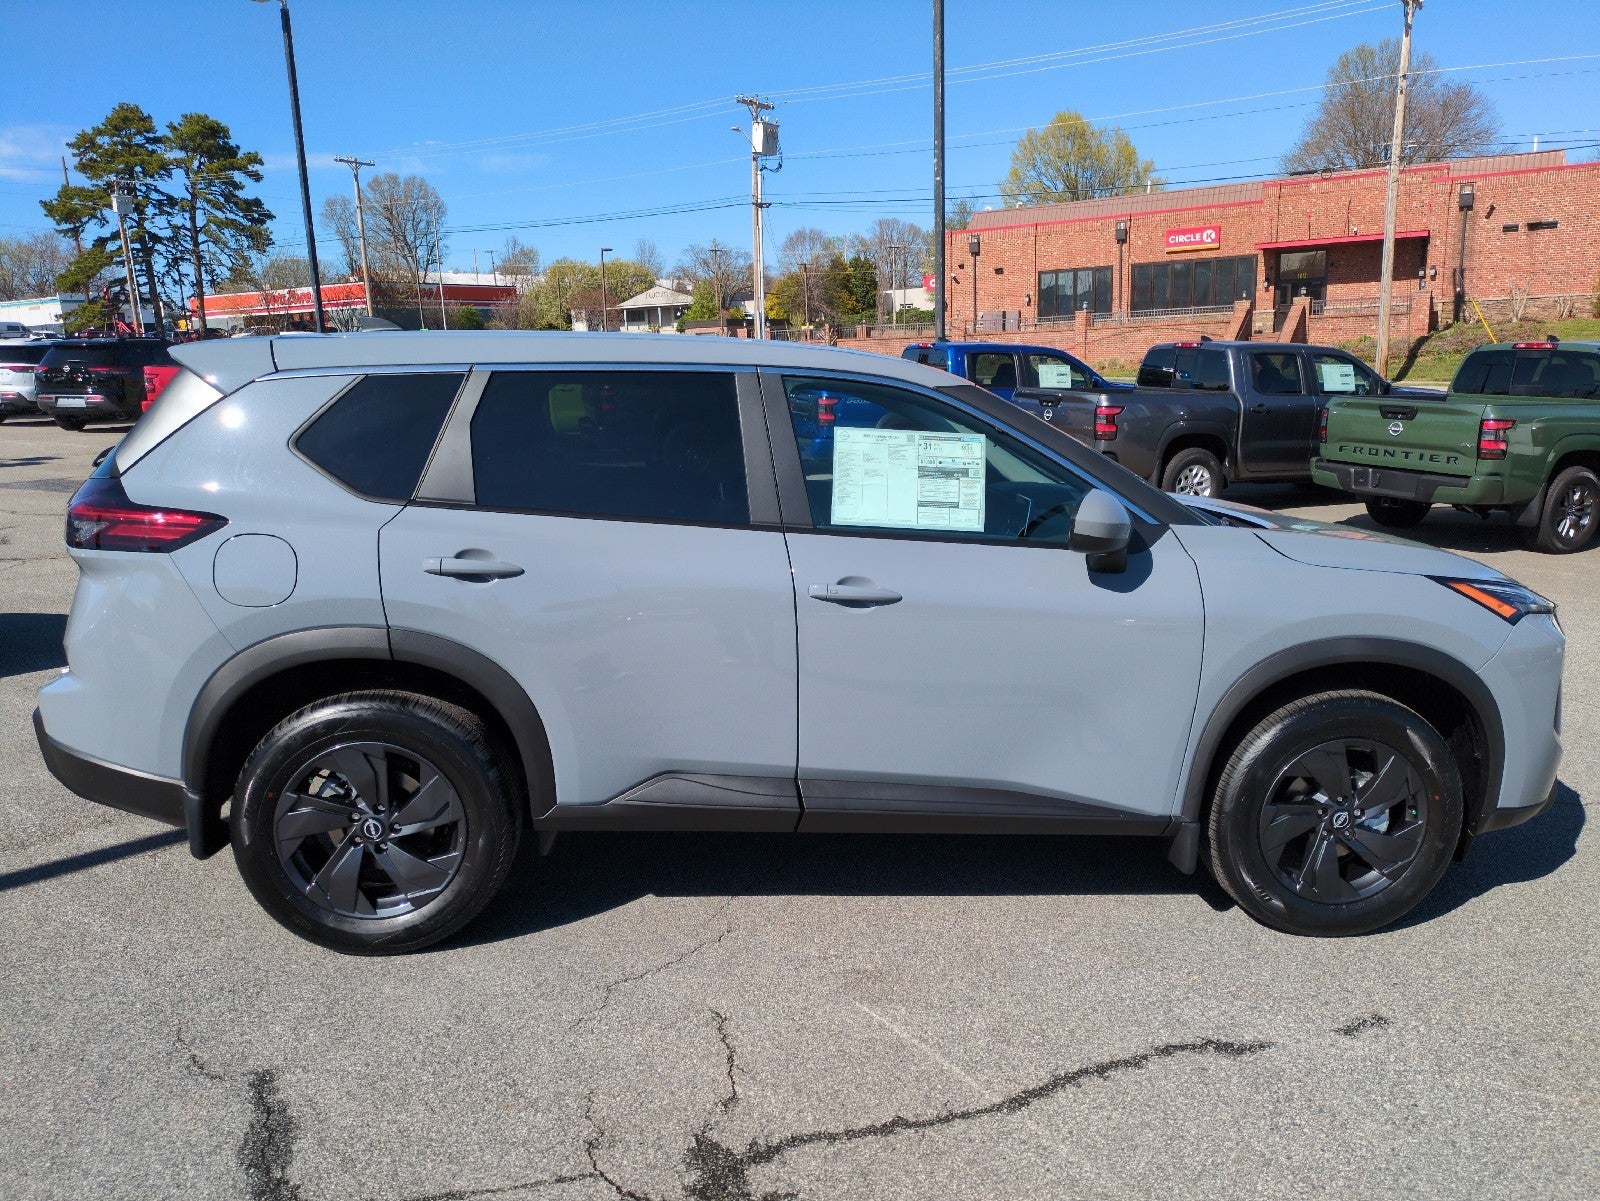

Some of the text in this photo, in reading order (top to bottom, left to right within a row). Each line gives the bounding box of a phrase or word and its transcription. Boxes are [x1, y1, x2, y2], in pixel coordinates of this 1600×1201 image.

[1169, 230, 1216, 244] CIRCLE K
[1338, 445, 1461, 465] FRONTIER
